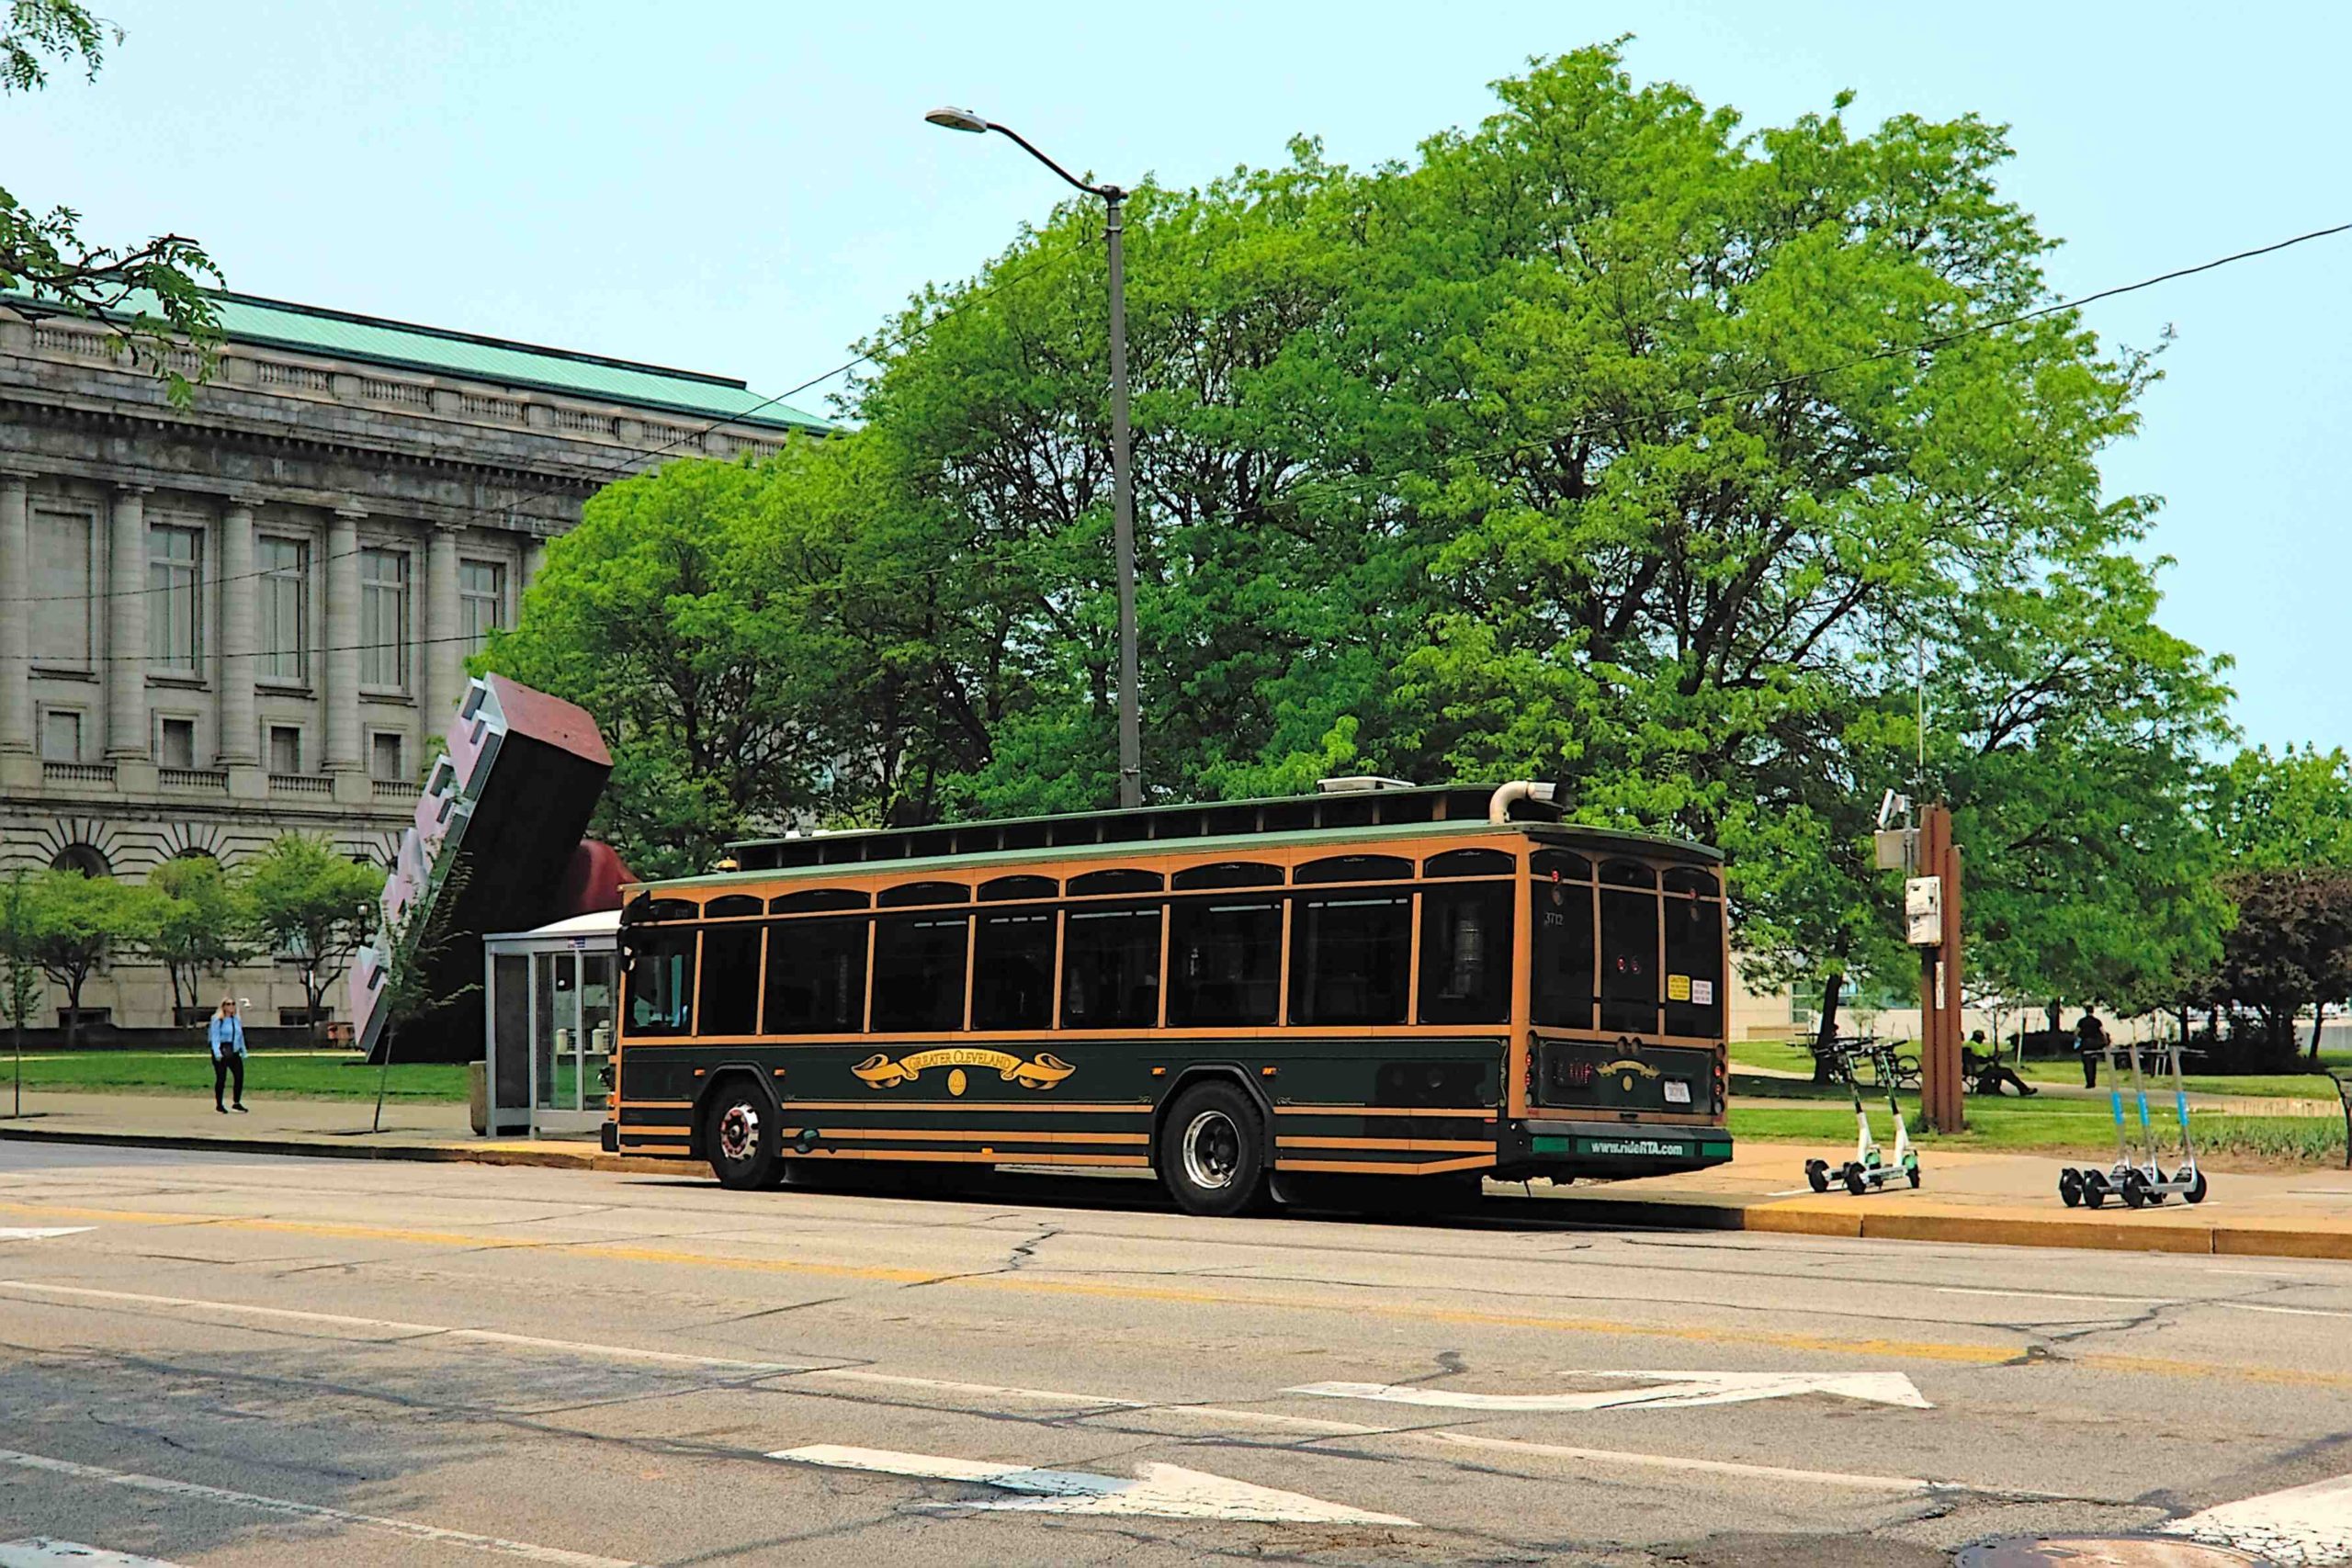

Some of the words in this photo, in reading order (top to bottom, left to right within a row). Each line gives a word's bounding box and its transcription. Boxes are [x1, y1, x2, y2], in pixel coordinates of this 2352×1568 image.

[909, 1053, 951, 1069] GREATER
[954, 1050, 1012, 1069] CLEVELAND
[1590, 1140, 1683, 1156] www.rideRTA.com
